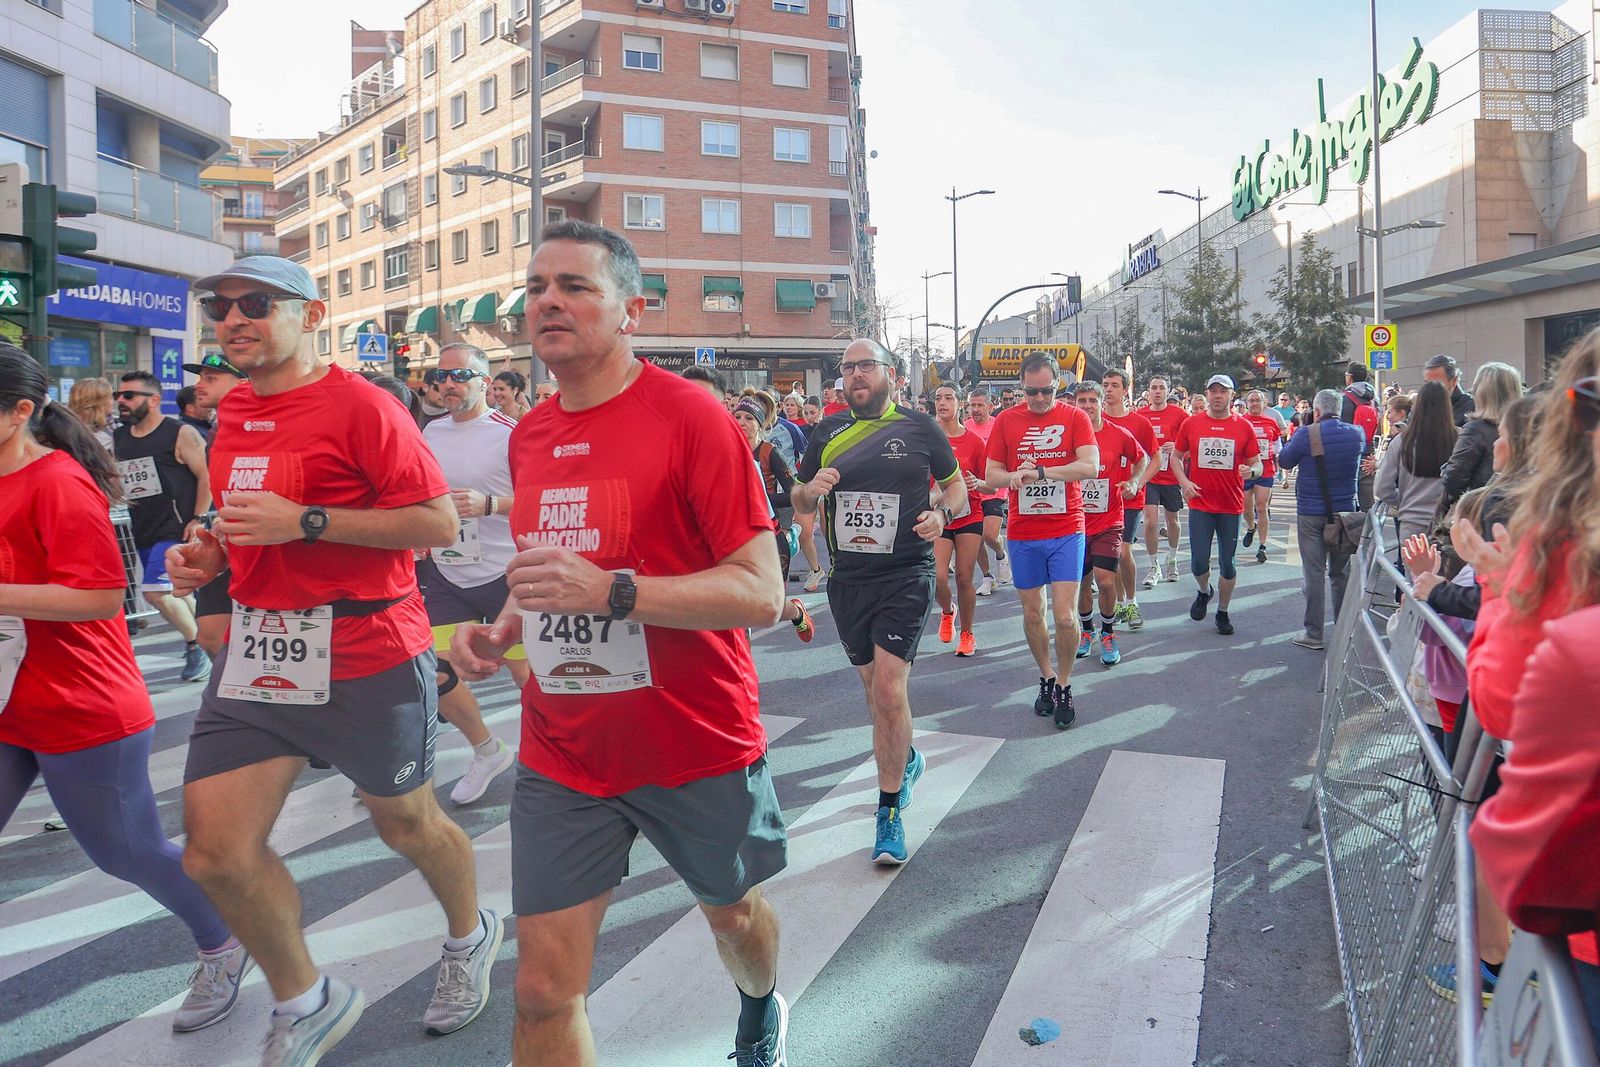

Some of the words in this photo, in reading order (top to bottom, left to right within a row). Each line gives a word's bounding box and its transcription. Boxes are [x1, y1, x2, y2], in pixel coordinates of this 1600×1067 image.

[1231, 155, 1255, 222] El
[1252, 129, 1312, 209] Corte
[1375, 332, 1387, 340] 30
[648, 356, 682, 366] Puerta
[1033, 450, 1067, 459] balance
[1204, 447, 1228, 457] 2659
[124, 471, 148, 484] 2189
[227, 469, 268, 490] PADRE
[540, 486, 590, 504] MEMORIAL
[1025, 485, 1056, 497] 2287
[1081, 490, 1100, 500] 762
[538, 502, 589, 530] PADRE
[844, 511, 885, 529] 2533
[538, 611, 614, 645] 2487
[243, 635, 308, 663] 2199
[559, 646, 592, 656] CARLOS
[263, 664, 281, 672] ELIAS
